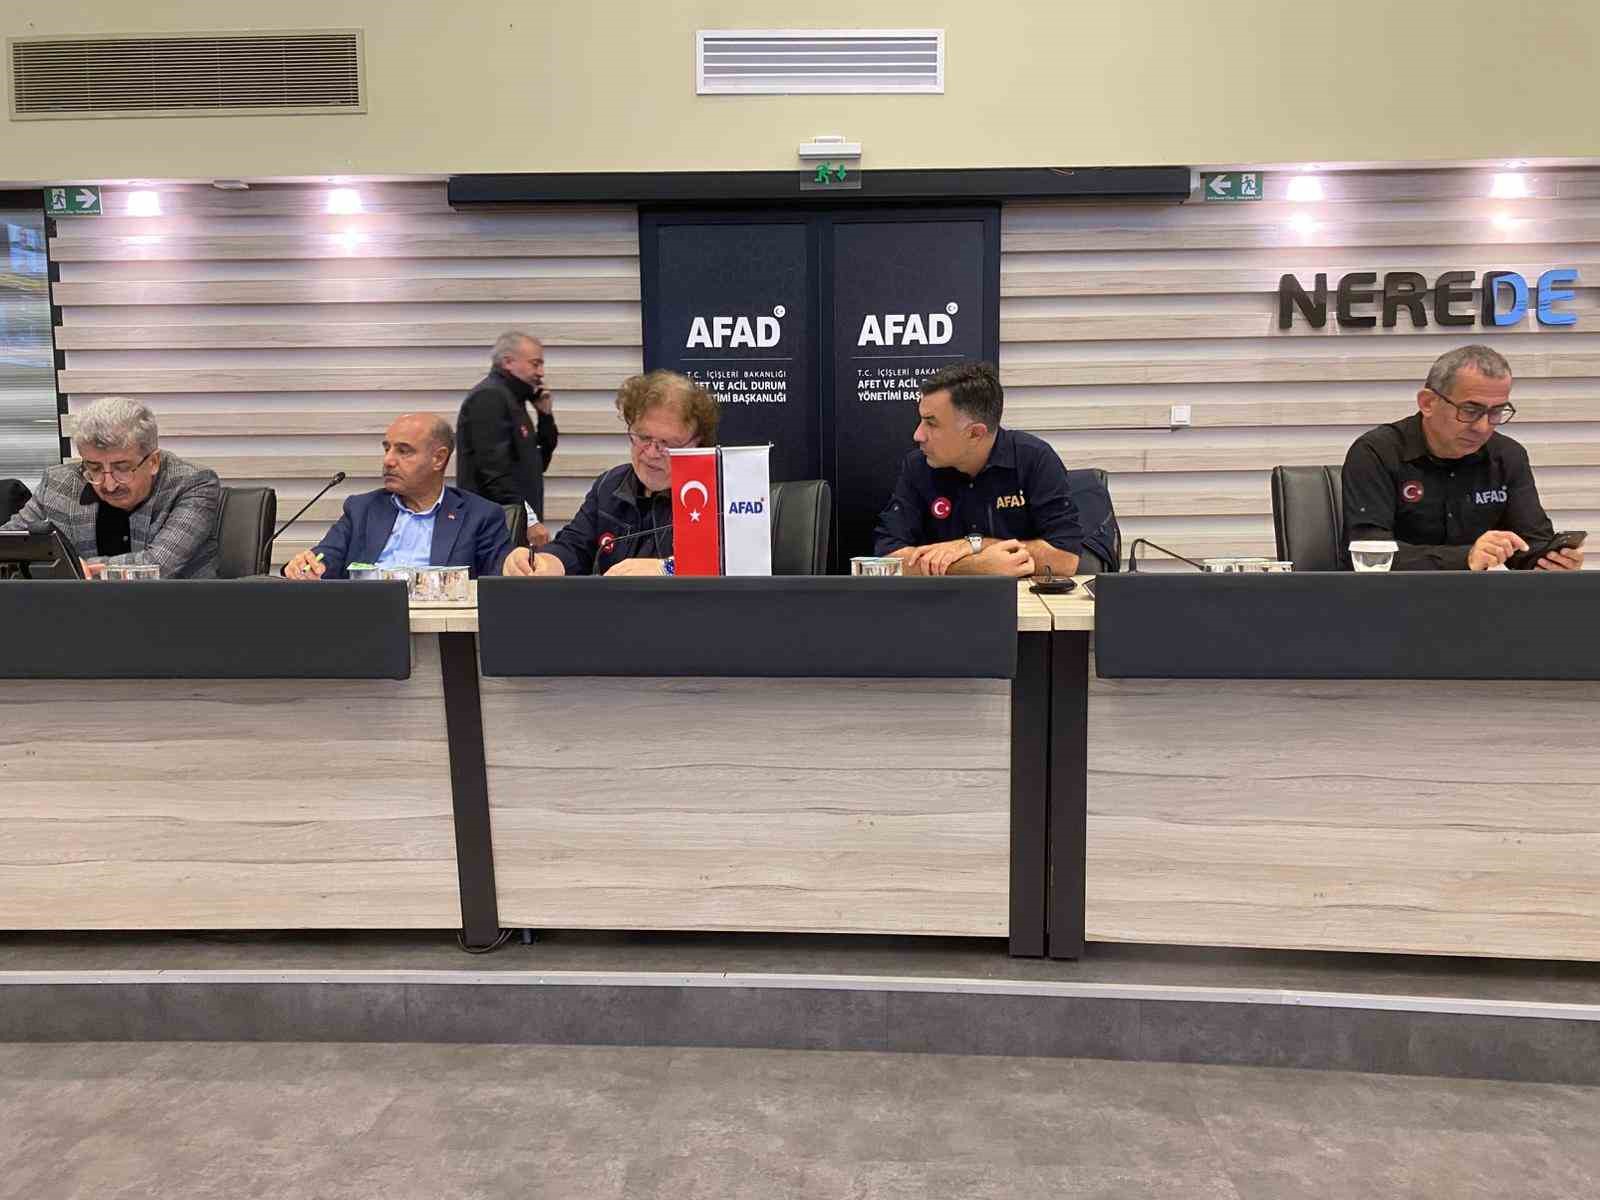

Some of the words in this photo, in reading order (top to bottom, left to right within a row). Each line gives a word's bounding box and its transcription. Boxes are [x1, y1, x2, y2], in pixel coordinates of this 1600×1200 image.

[1279, 269, 1578, 330] NEREDE
[686, 316, 781, 348] AFAD
[857, 314, 953, 346] AFAD
[706, 370, 739, 379] İÇİŞLERİ
[744, 369, 786, 378] BAKANLIĞI
[713, 381, 725, 391] VE
[727, 379, 748, 391] ACİL
[751, 381, 786, 391] DURUM
[857, 379, 881, 389] AFET
[883, 379, 896, 389] VE
[898, 377, 919, 388] ACİL
[732, 392, 786, 406] BAŞKANLIĞI
[857, 390, 902, 401] YÖNETİMİ
[1475, 490, 1508, 504] AFAD
[729, 501, 763, 514] AFAD
